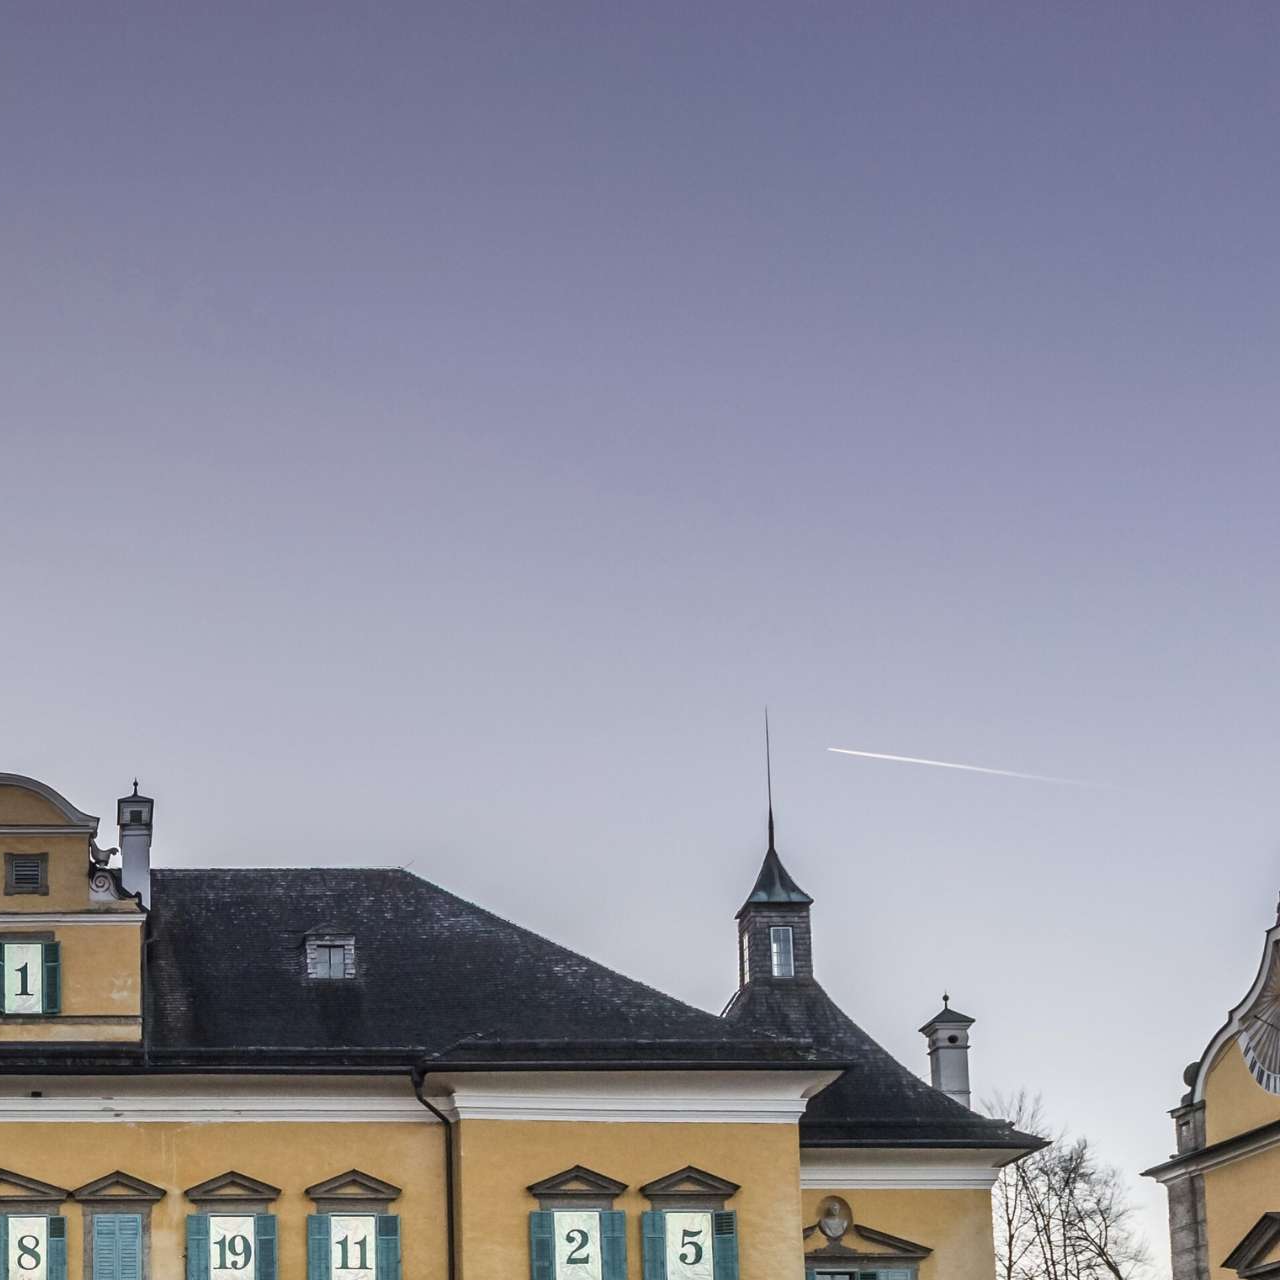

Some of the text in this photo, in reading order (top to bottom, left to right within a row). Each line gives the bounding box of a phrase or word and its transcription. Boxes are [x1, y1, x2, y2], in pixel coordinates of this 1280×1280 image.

[15, 962, 34, 996] 1
[17, 1235, 41, 1271] 8
[213, 1234, 252, 1270] 19
[335, 1235, 373, 1270] 11
[565, 1229, 590, 1264] 2
[679, 1229, 703, 1265] 5
